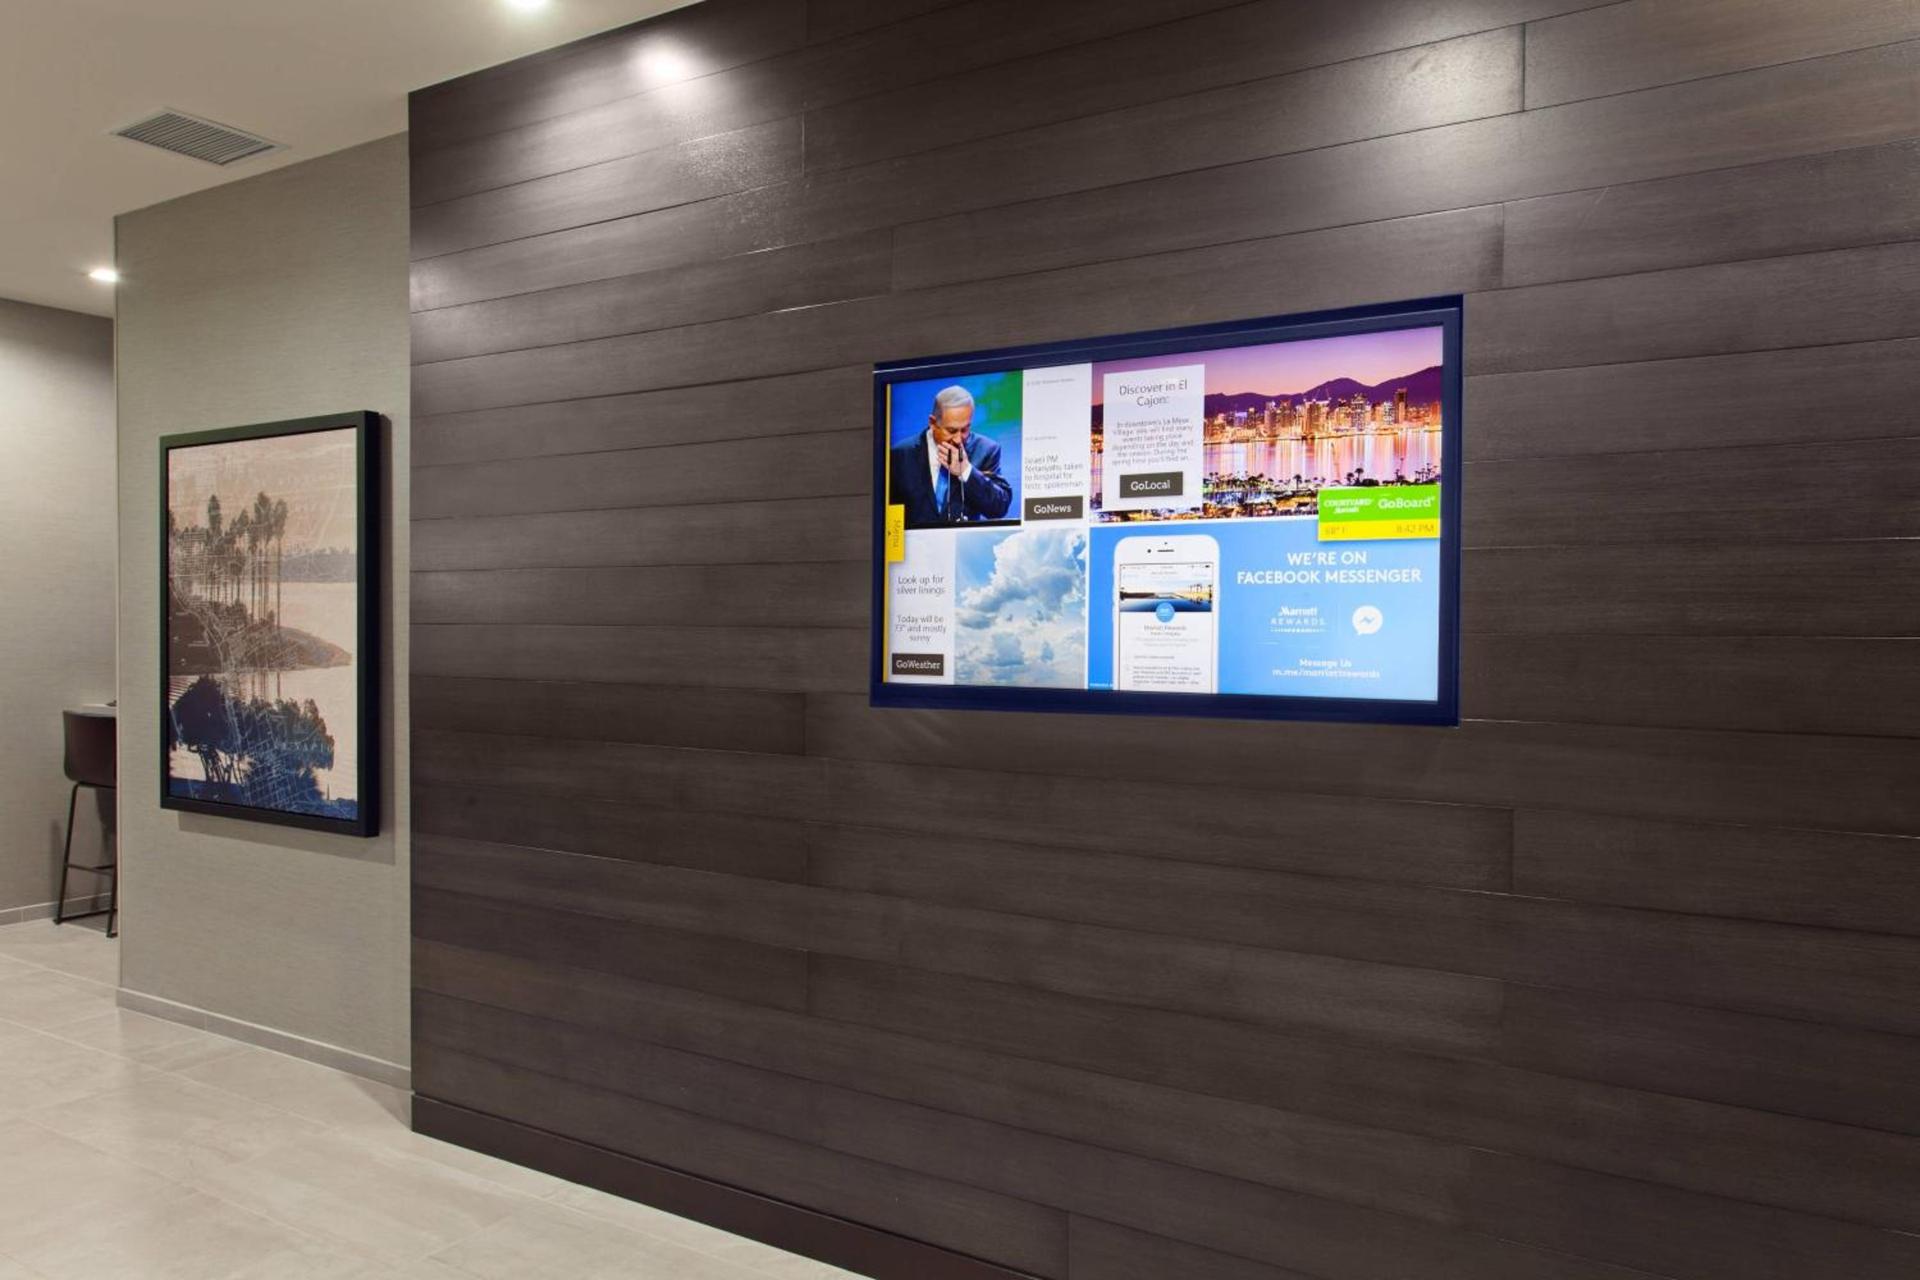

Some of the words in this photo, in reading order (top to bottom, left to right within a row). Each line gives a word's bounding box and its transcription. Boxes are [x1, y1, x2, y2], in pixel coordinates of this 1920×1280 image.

[1119, 384, 1162, 396] Discover
[1165, 382, 1176, 391] in
[1179, 379, 1188, 390] El
[1130, 479, 1171, 491] GoLocal
[1033, 503, 1072, 514] GoNews
[1340, 551, 1367, 565] ON
[897, 575, 917, 585] Look
[919, 576, 931, 587] up
[932, 574, 944, 583] for
[1237, 571, 1320, 585] FACEBOOK
[1325, 569, 1422, 583] MESSENGER
[896, 586, 917, 595] silver
[918, 586, 945, 597] linings
[897, 615, 919, 624] Today
[919, 615, 932, 623] will
[933, 615, 944, 623] be
[895, 659, 941, 670] GoWeather
